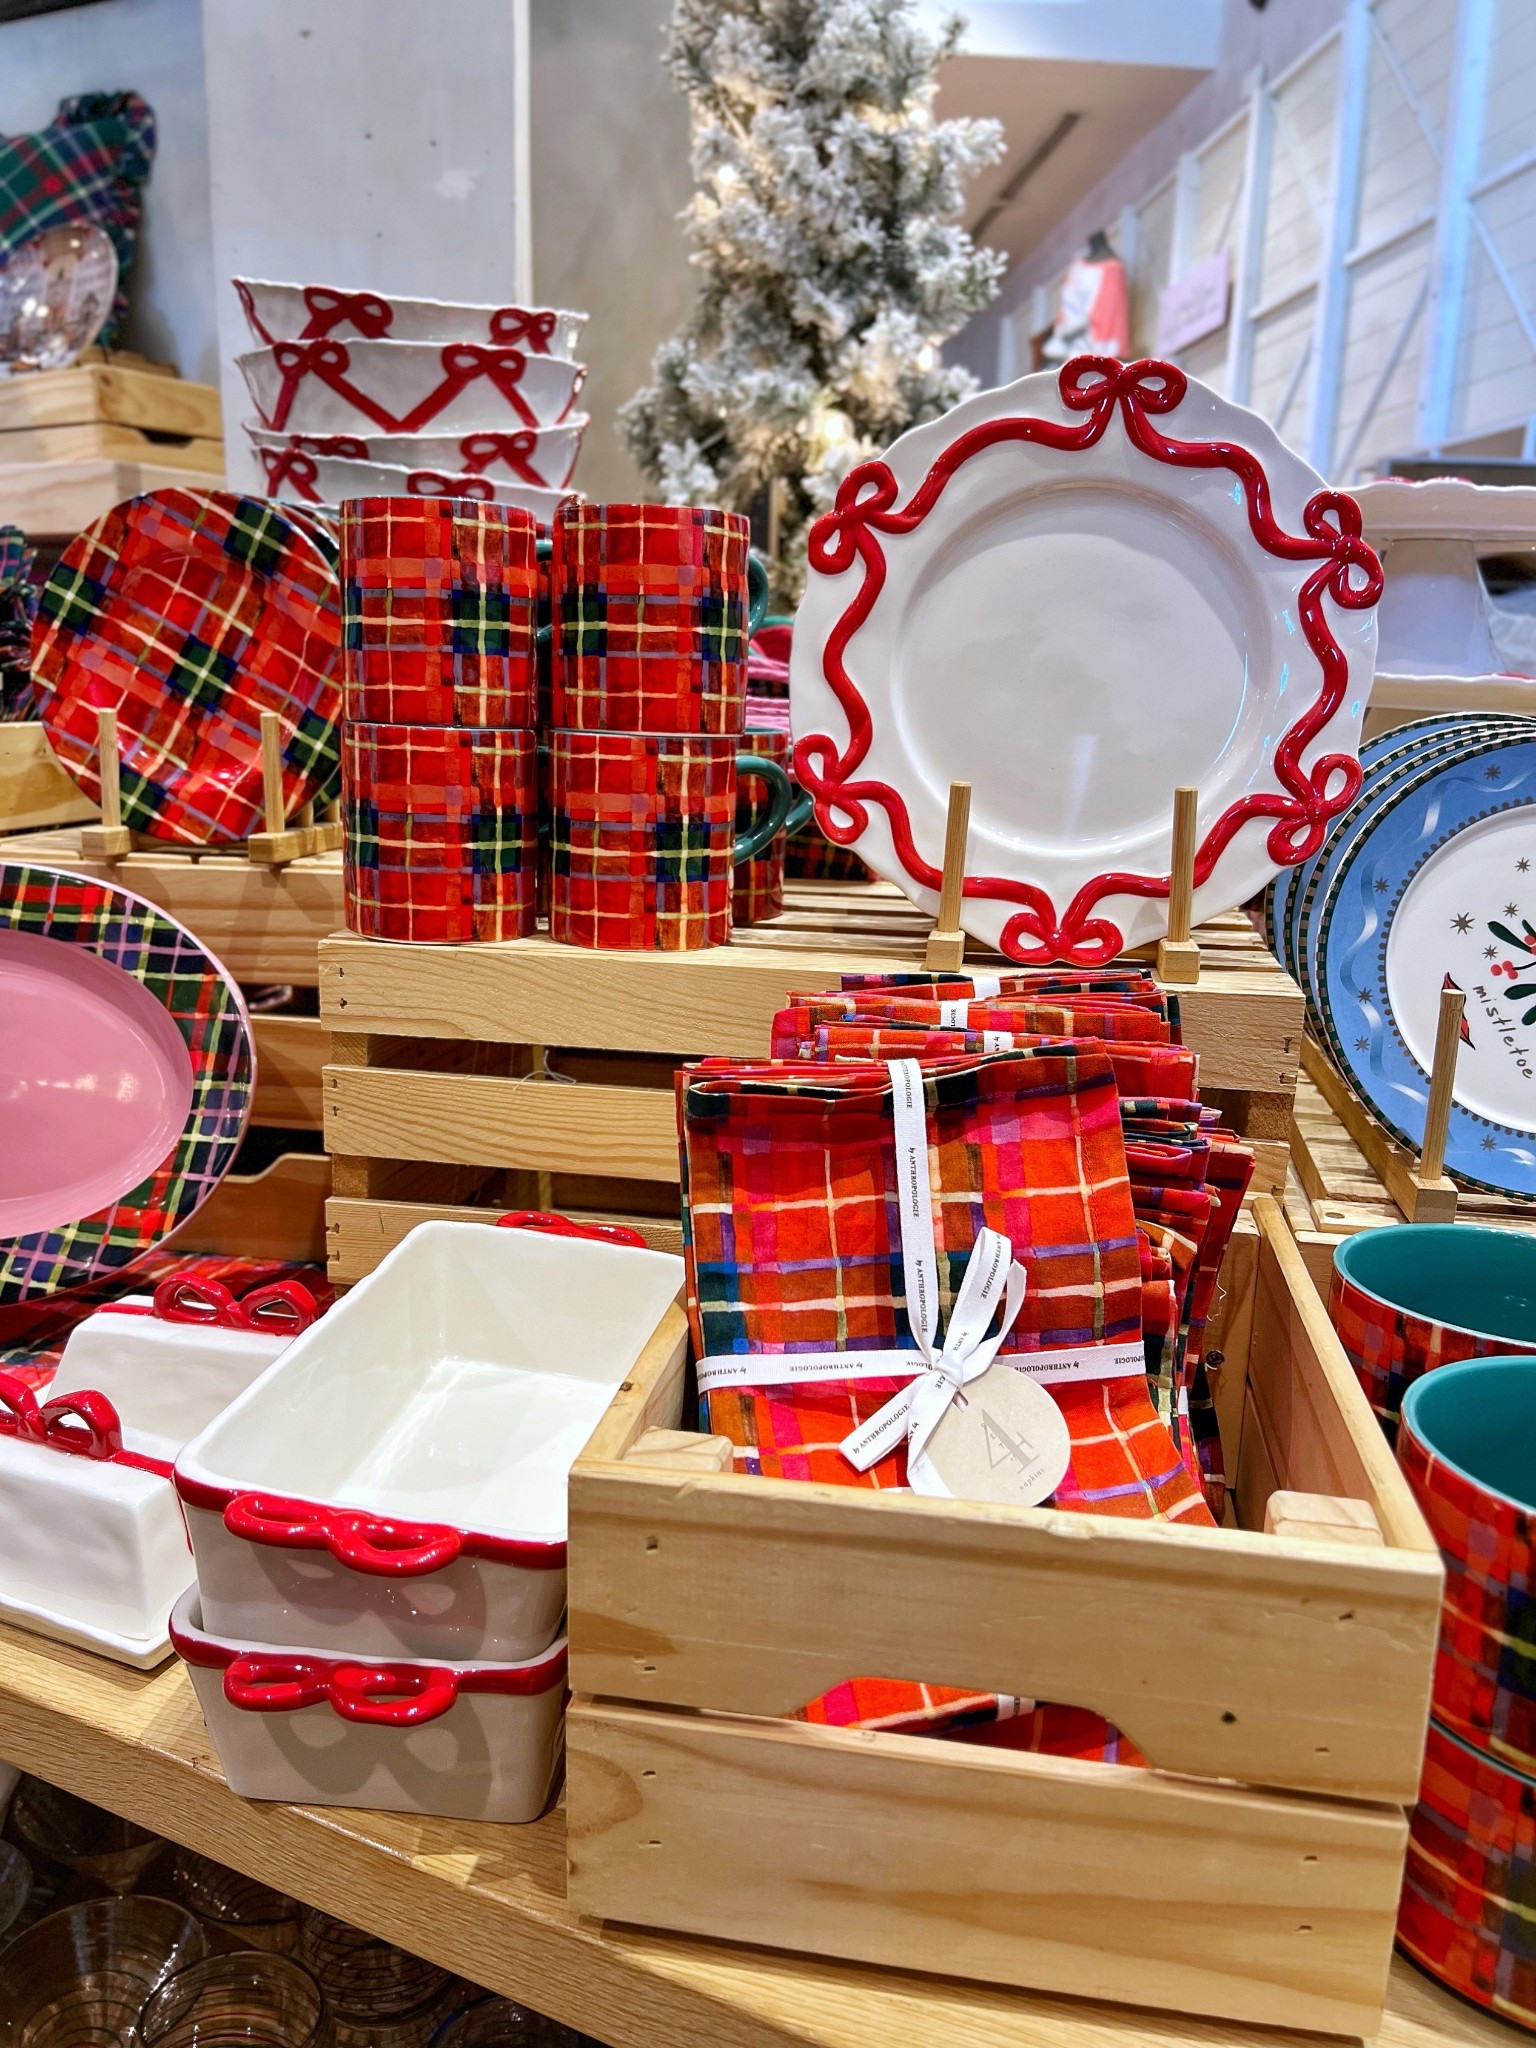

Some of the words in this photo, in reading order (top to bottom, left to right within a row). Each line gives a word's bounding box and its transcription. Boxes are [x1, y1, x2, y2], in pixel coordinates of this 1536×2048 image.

[1473, 985, 1533, 1079] mistletoe
[908, 1156, 919, 1218] ANTHROPOLOGIE
[915, 1259, 923, 1267] by
[916, 1268, 928, 1334] ANTHROPOLOGIE
[789, 1363, 854, 1372] ANTHROPOLOGIE
[1073, 1361, 1080, 1369] by
[852, 1447, 860, 1455] by
[859, 1403, 910, 1449] ANTHROPOLOGIE
